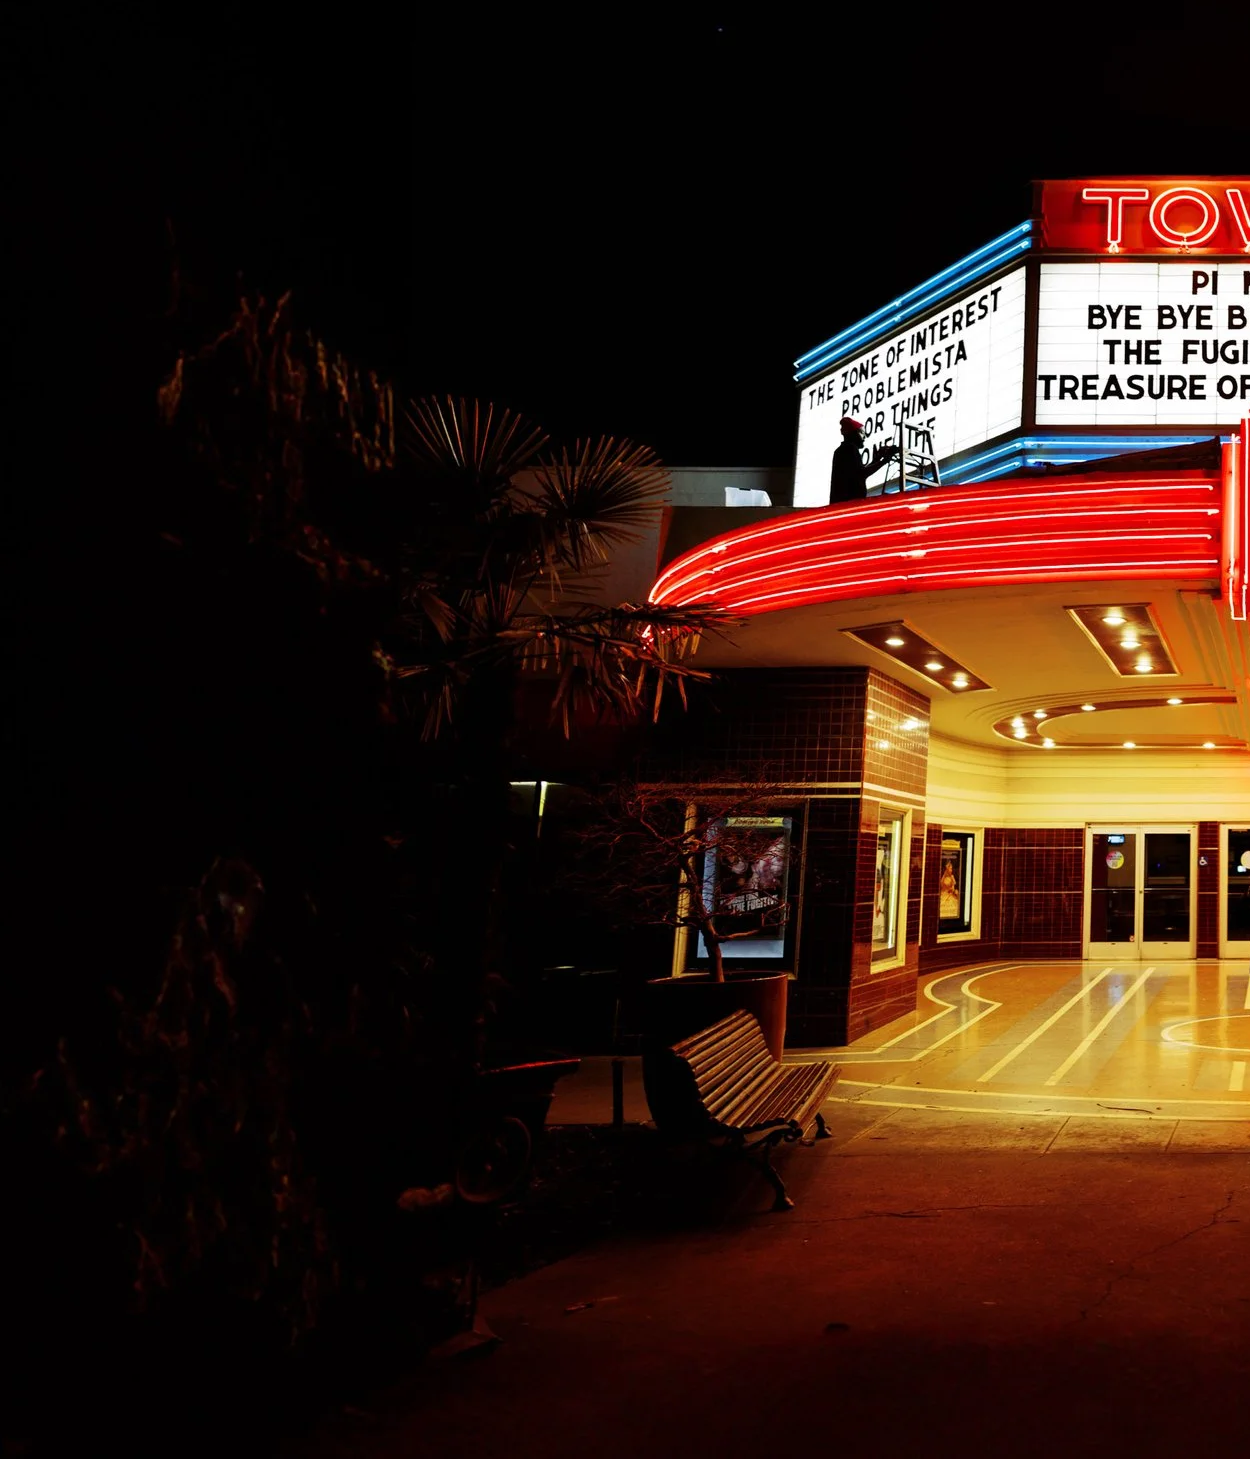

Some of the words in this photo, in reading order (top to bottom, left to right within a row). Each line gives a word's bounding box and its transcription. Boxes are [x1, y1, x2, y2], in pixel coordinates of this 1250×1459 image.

[1191, 270, 1219, 296] PI
[1087, 304, 1143, 330] BYE
[1157, 304, 1213, 330] BYE
[809, 378, 835, 410] THE
[842, 353, 880, 395] ZONE
[886, 338, 907, 368] OF
[910, 286, 1003, 357] INTEREST
[1102, 339, 1162, 365] THE
[842, 339, 968, 418] PROBLEMISTA
[1037, 374, 1207, 400] TREASURE
[891, 378, 953, 426] THINGS
